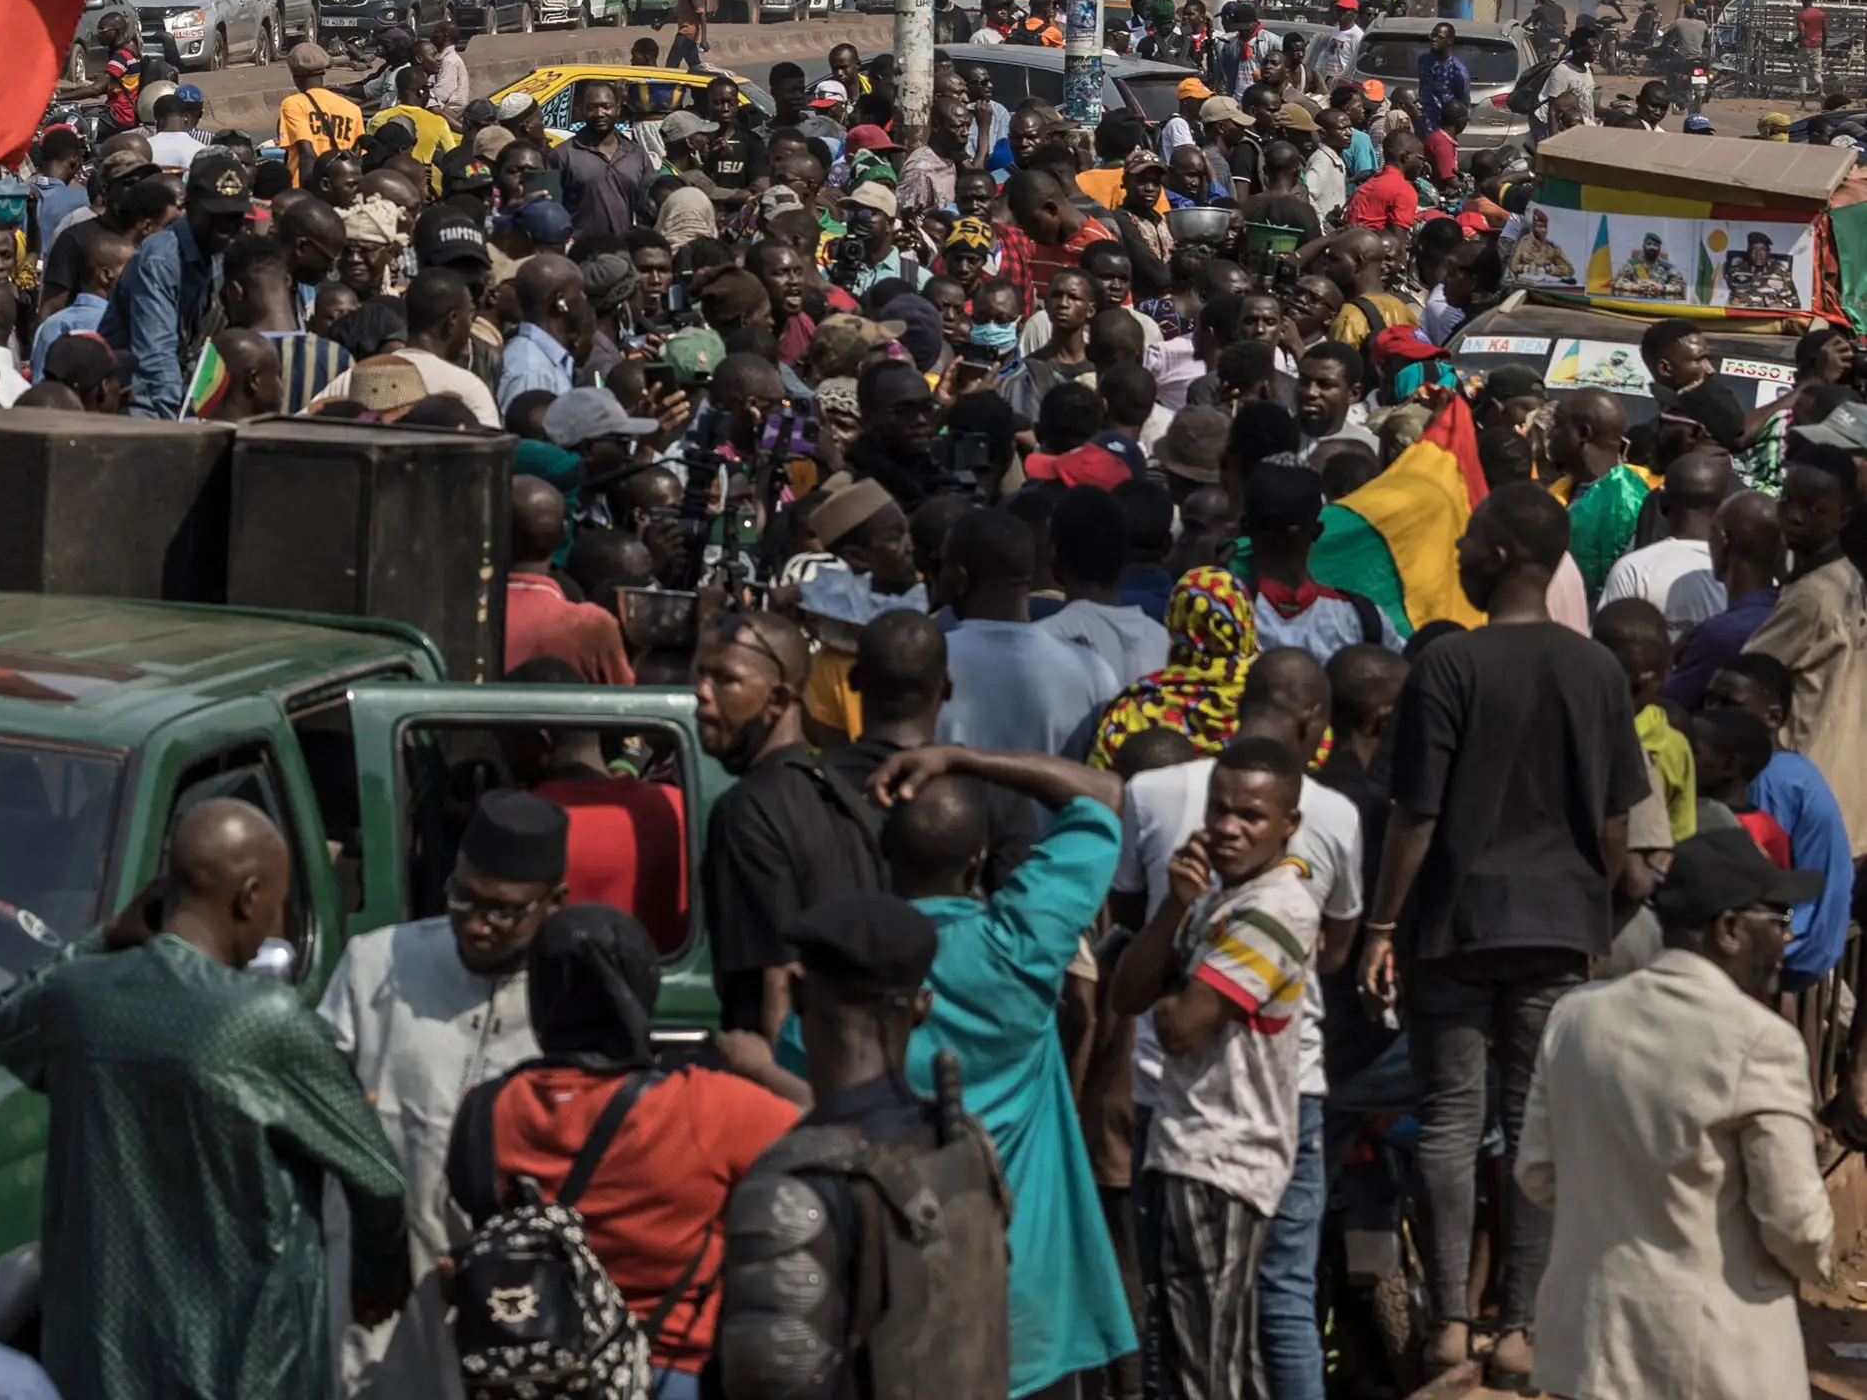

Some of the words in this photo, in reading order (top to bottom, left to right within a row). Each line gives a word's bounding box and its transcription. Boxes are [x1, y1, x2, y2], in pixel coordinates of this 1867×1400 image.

[717, 161, 744, 173] ISU
[1488, 338, 1510, 352] KA
[1725, 361, 1781, 379] FASSO
